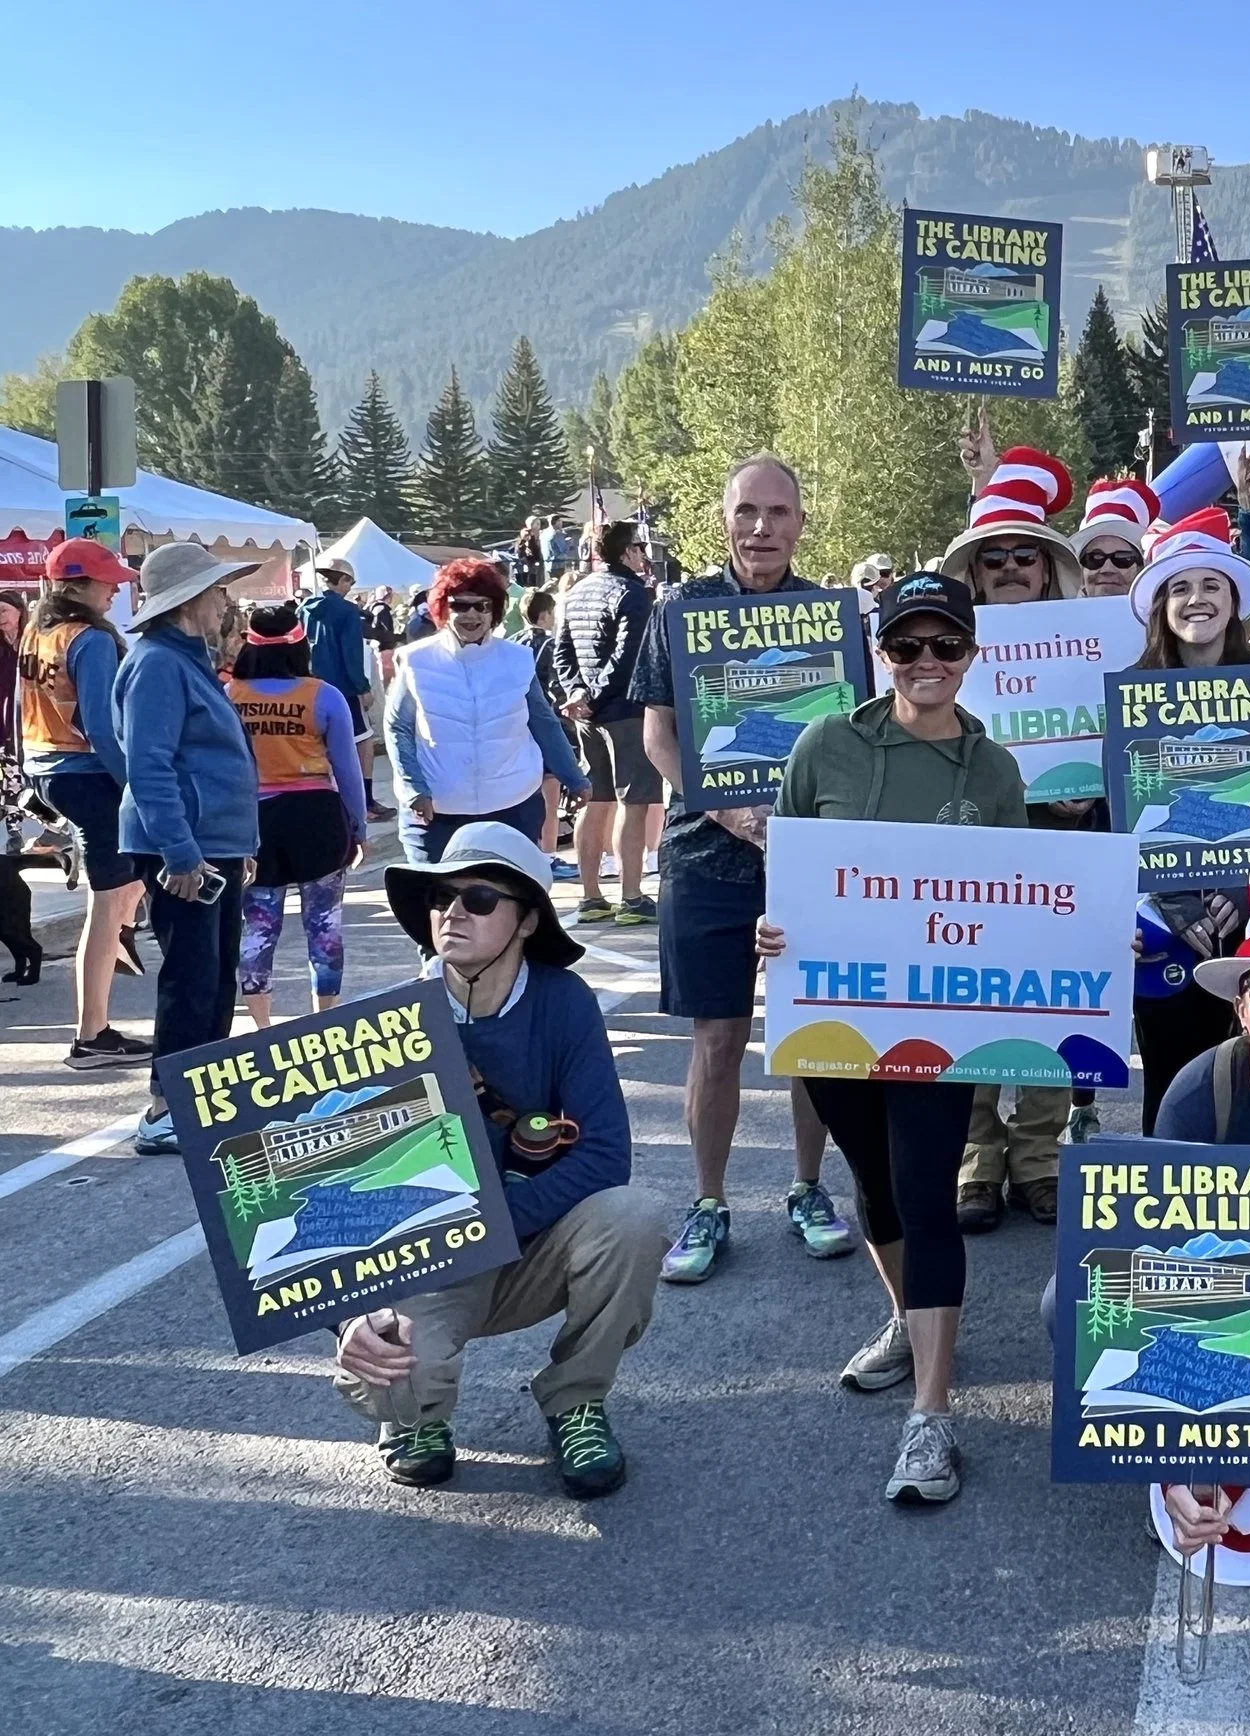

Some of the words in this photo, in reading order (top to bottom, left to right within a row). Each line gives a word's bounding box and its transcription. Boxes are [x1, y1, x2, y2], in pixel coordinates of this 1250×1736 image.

[916, 220, 954, 239] THE
[962, 224, 1048, 248] LIBRARY
[917, 236, 937, 256] IS
[946, 240, 1046, 266] CALLING
[1178, 272, 1216, 290] THE
[1180, 289, 1200, 309] IS
[913, 358, 950, 372] AND
[956, 361, 961, 373] I
[968, 362, 1013, 377] MUST
[1020, 366, 1044, 379] GO
[1186, 411, 1222, 424] AND
[1228, 410, 1232, 422] I
[682, 609, 730, 631] THE
[739, 600, 841, 627] LIBRARY
[687, 630, 712, 653] IS
[722, 620, 843, 650] CALLING
[981, 633, 1102, 662] running
[995, 670, 1037, 696] for
[1119, 682, 1167, 704] THE
[233, 702, 306, 718] VISUALLY
[992, 704, 1106, 741] LIBRA
[1122, 704, 1147, 728] IS
[1165, 753, 1218, 766] LIBRARY
[702, 771, 745, 788] AND
[752, 769, 758, 783] I
[1185, 851, 1191, 866] I
[834, 867, 898, 899] I'm
[913, 874, 1075, 915] running
[926, 912, 983, 945] for
[799, 960, 886, 999] THE
[908, 965, 1112, 1009] LIBRARY
[184, 1051, 260, 1095] THE
[270, 1002, 421, 1071] LIBRARY
[195, 1089, 237, 1128] IS
[251, 1030, 432, 1108] CALLING
[865, 1063, 880, 1072] to
[885, 1064, 910, 1073] run
[915, 1064, 942, 1074] and
[947, 1066, 997, 1076] donate
[1002, 1068, 1017, 1077] at
[274, 1126, 353, 1163] LIBRARY
[1080, 1165, 1147, 1194] THE
[1082, 1195, 1117, 1229] IS
[258, 1278, 322, 1316] AND
[331, 1268, 343, 1289] I
[356, 1237, 430, 1282] MUST
[445, 1221, 486, 1248] GO
[294, 1299, 335, 1318] TETON
[342, 1279, 393, 1302] COUNTY
[401, 1259, 453, 1282] LIBRARY
[1139, 1276, 1215, 1291] LIBRARY
[1079, 1424, 1145, 1447] AND
[1157, 1424, 1164, 1447] I
[1160, 1456, 1212, 1464] COUNTY
